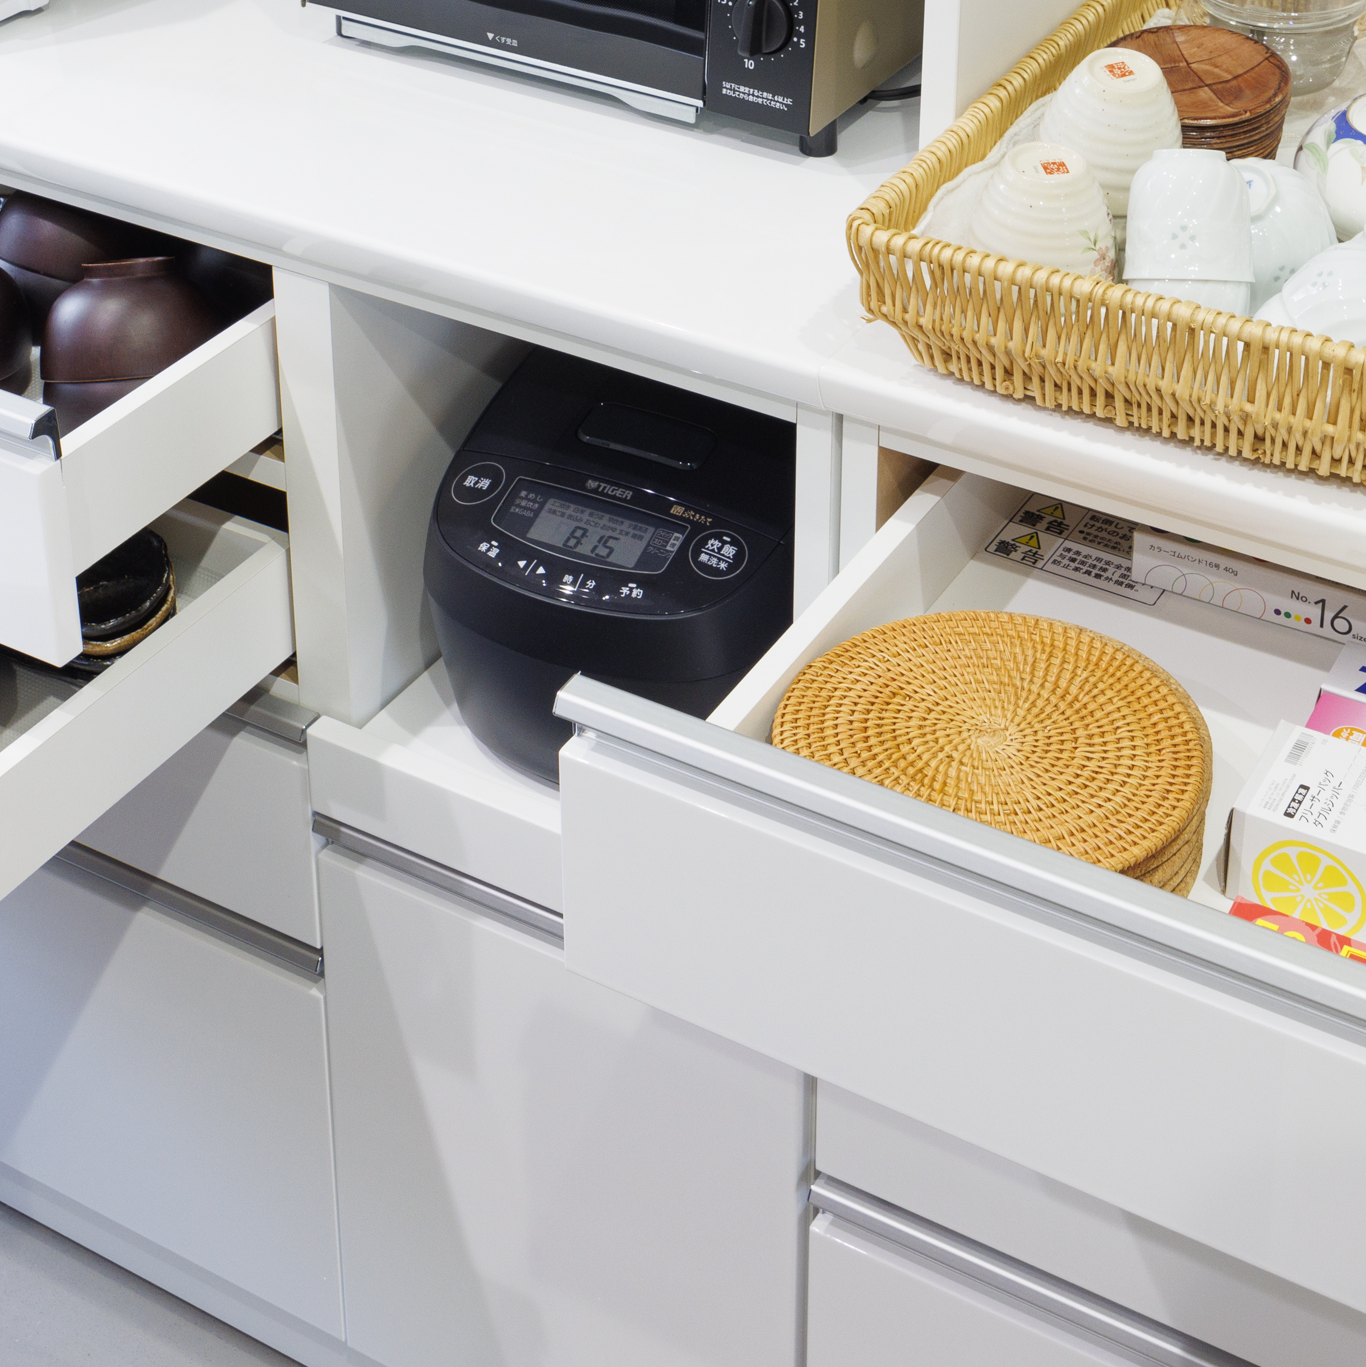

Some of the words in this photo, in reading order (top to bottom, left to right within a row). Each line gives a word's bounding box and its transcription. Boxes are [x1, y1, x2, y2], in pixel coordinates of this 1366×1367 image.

[798, 11, 804, 19] 3
[799, 25, 805, 33] 4
[799, 39, 806, 48] 5
[743, 58, 755, 70] 10
[463, 475, 492, 491] 取消
[597, 482, 633, 500] TIGER
[1019, 508, 1072, 537] 警告
[477, 541, 500, 559] 保温
[562, 525, 622, 561] 8:15
[651, 537, 668, 548] スロー
[704, 538, 738, 559] 炊飯
[993, 538, 1046, 566] 警告
[1148, 542, 1223, 573] カラーゴムバンド16号
[1222, 564, 1239, 578] 40g
[697, 552, 729, 571] 無洗米
[562, 573, 574, 584] 時
[585, 579, 597, 589] 分
[1050, 557, 1140, 595] 防止家具意外倾倒。
[619, 586, 644, 599] 予約
[1289, 589, 1313, 606] No.
[1313, 596, 1354, 637] 16
[1298, 768, 1335, 825] フリーザーバッグ
[1312, 780, 1344, 829] ダブルジッパー
